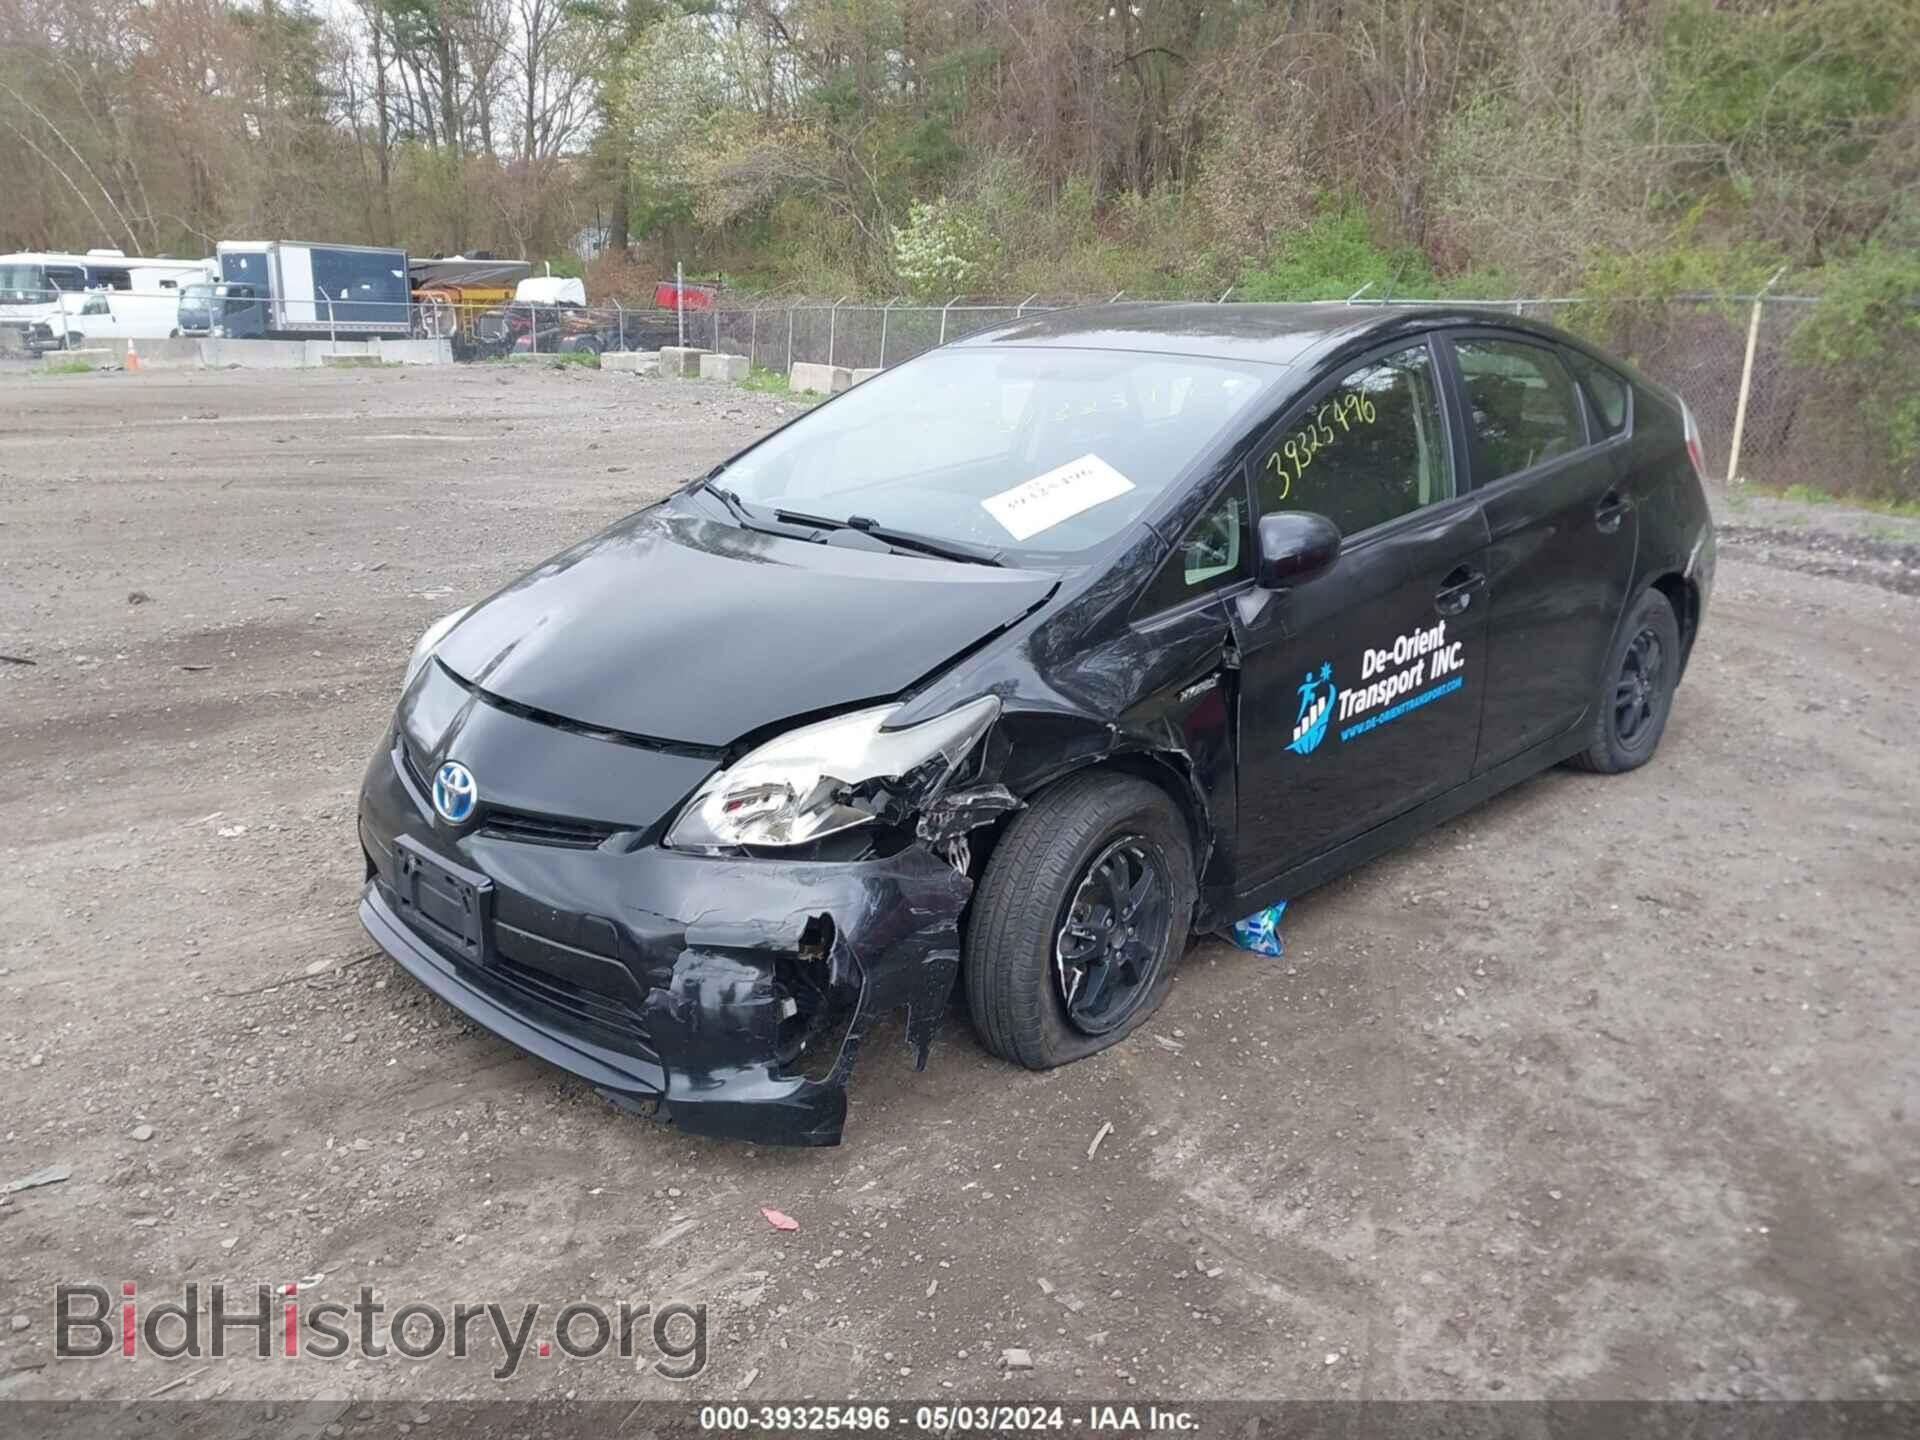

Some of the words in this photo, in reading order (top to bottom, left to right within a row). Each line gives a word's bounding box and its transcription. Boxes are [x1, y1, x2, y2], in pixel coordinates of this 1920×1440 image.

[1266, 386, 1376, 500] 39325496
[1338, 658, 1425, 721] Transport
[1430, 641, 1465, 680] INC.
[1361, 619, 1446, 680] De-Orient
